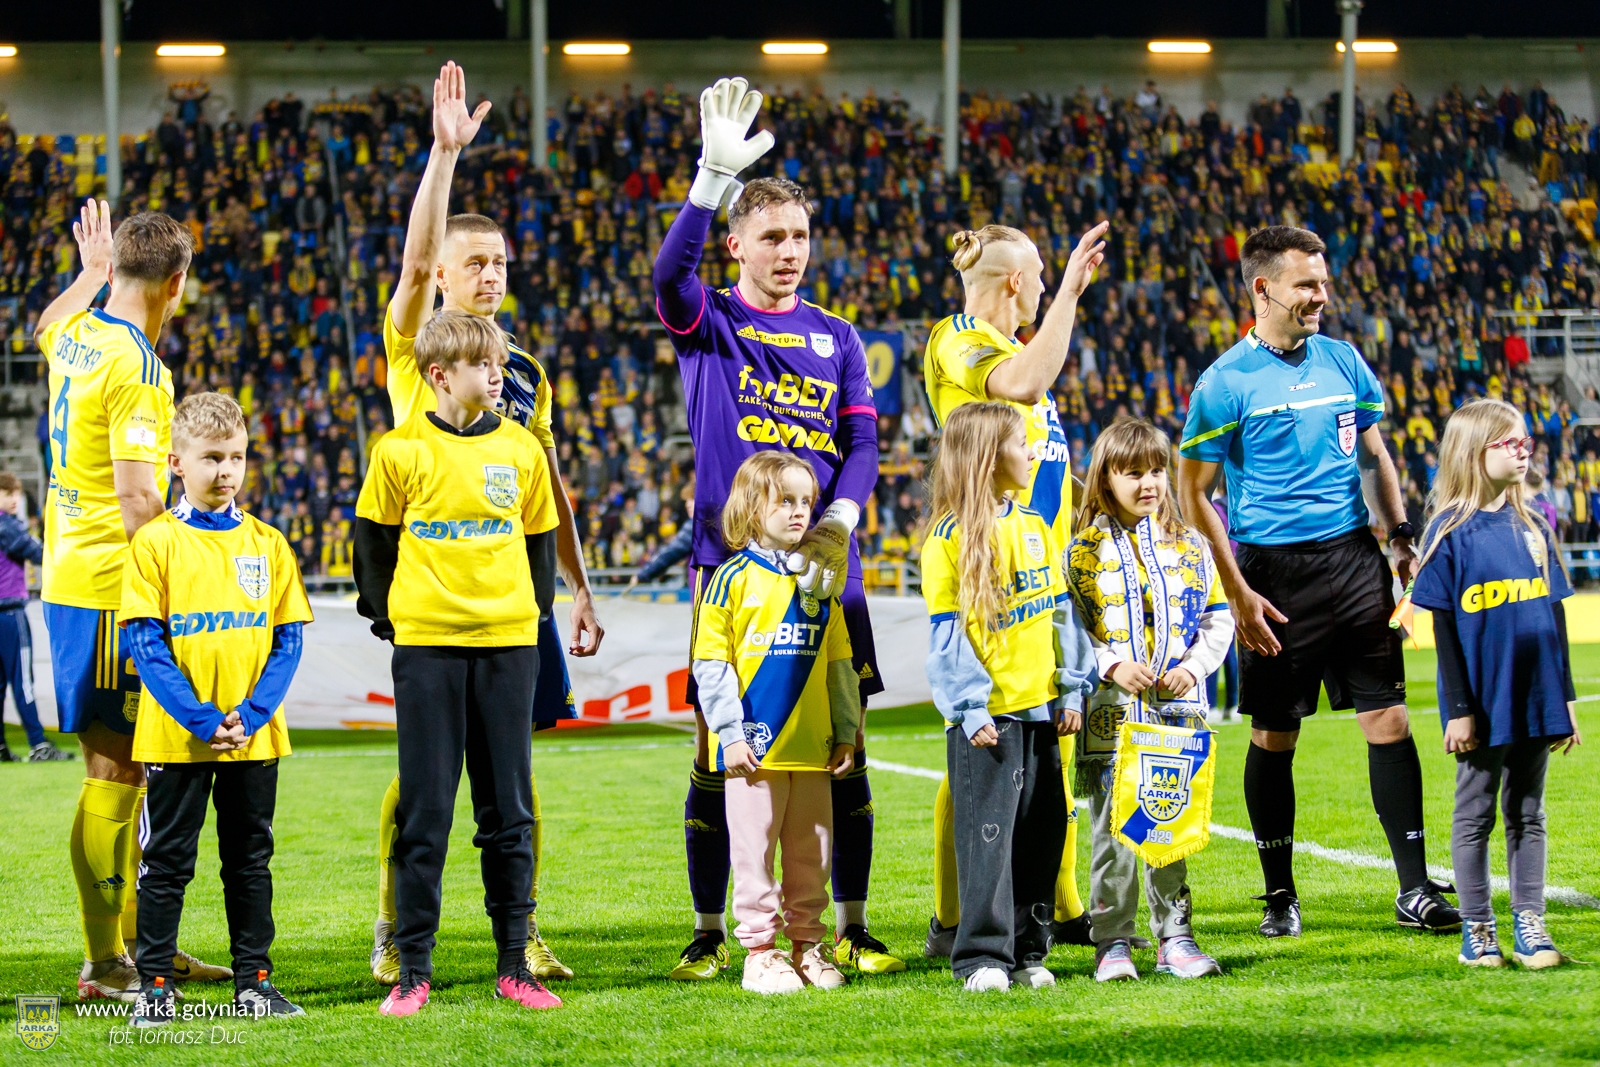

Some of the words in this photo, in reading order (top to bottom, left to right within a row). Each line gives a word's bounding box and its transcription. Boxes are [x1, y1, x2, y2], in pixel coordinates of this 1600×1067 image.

[757, 335, 803, 344] FORTUNA
[738, 365, 838, 412] forBET
[494, 397, 536, 429] BET
[738, 394, 772, 411] ZAKŁDY
[736, 414, 839, 457] GDYNIA
[490, 487, 515, 495] ARKA
[409, 519, 513, 540] GDYNIA
[1116, 536, 1138, 599] 2023/2024
[168, 611, 267, 637] GDYNIA
[745, 622, 821, 648] forBET
[1131, 730, 1161, 747] ARKA
[1163, 734, 1204, 752] GDYNIA
[1147, 790, 1181, 800] ARKA
[1146, 828, 1173, 844] 1929
